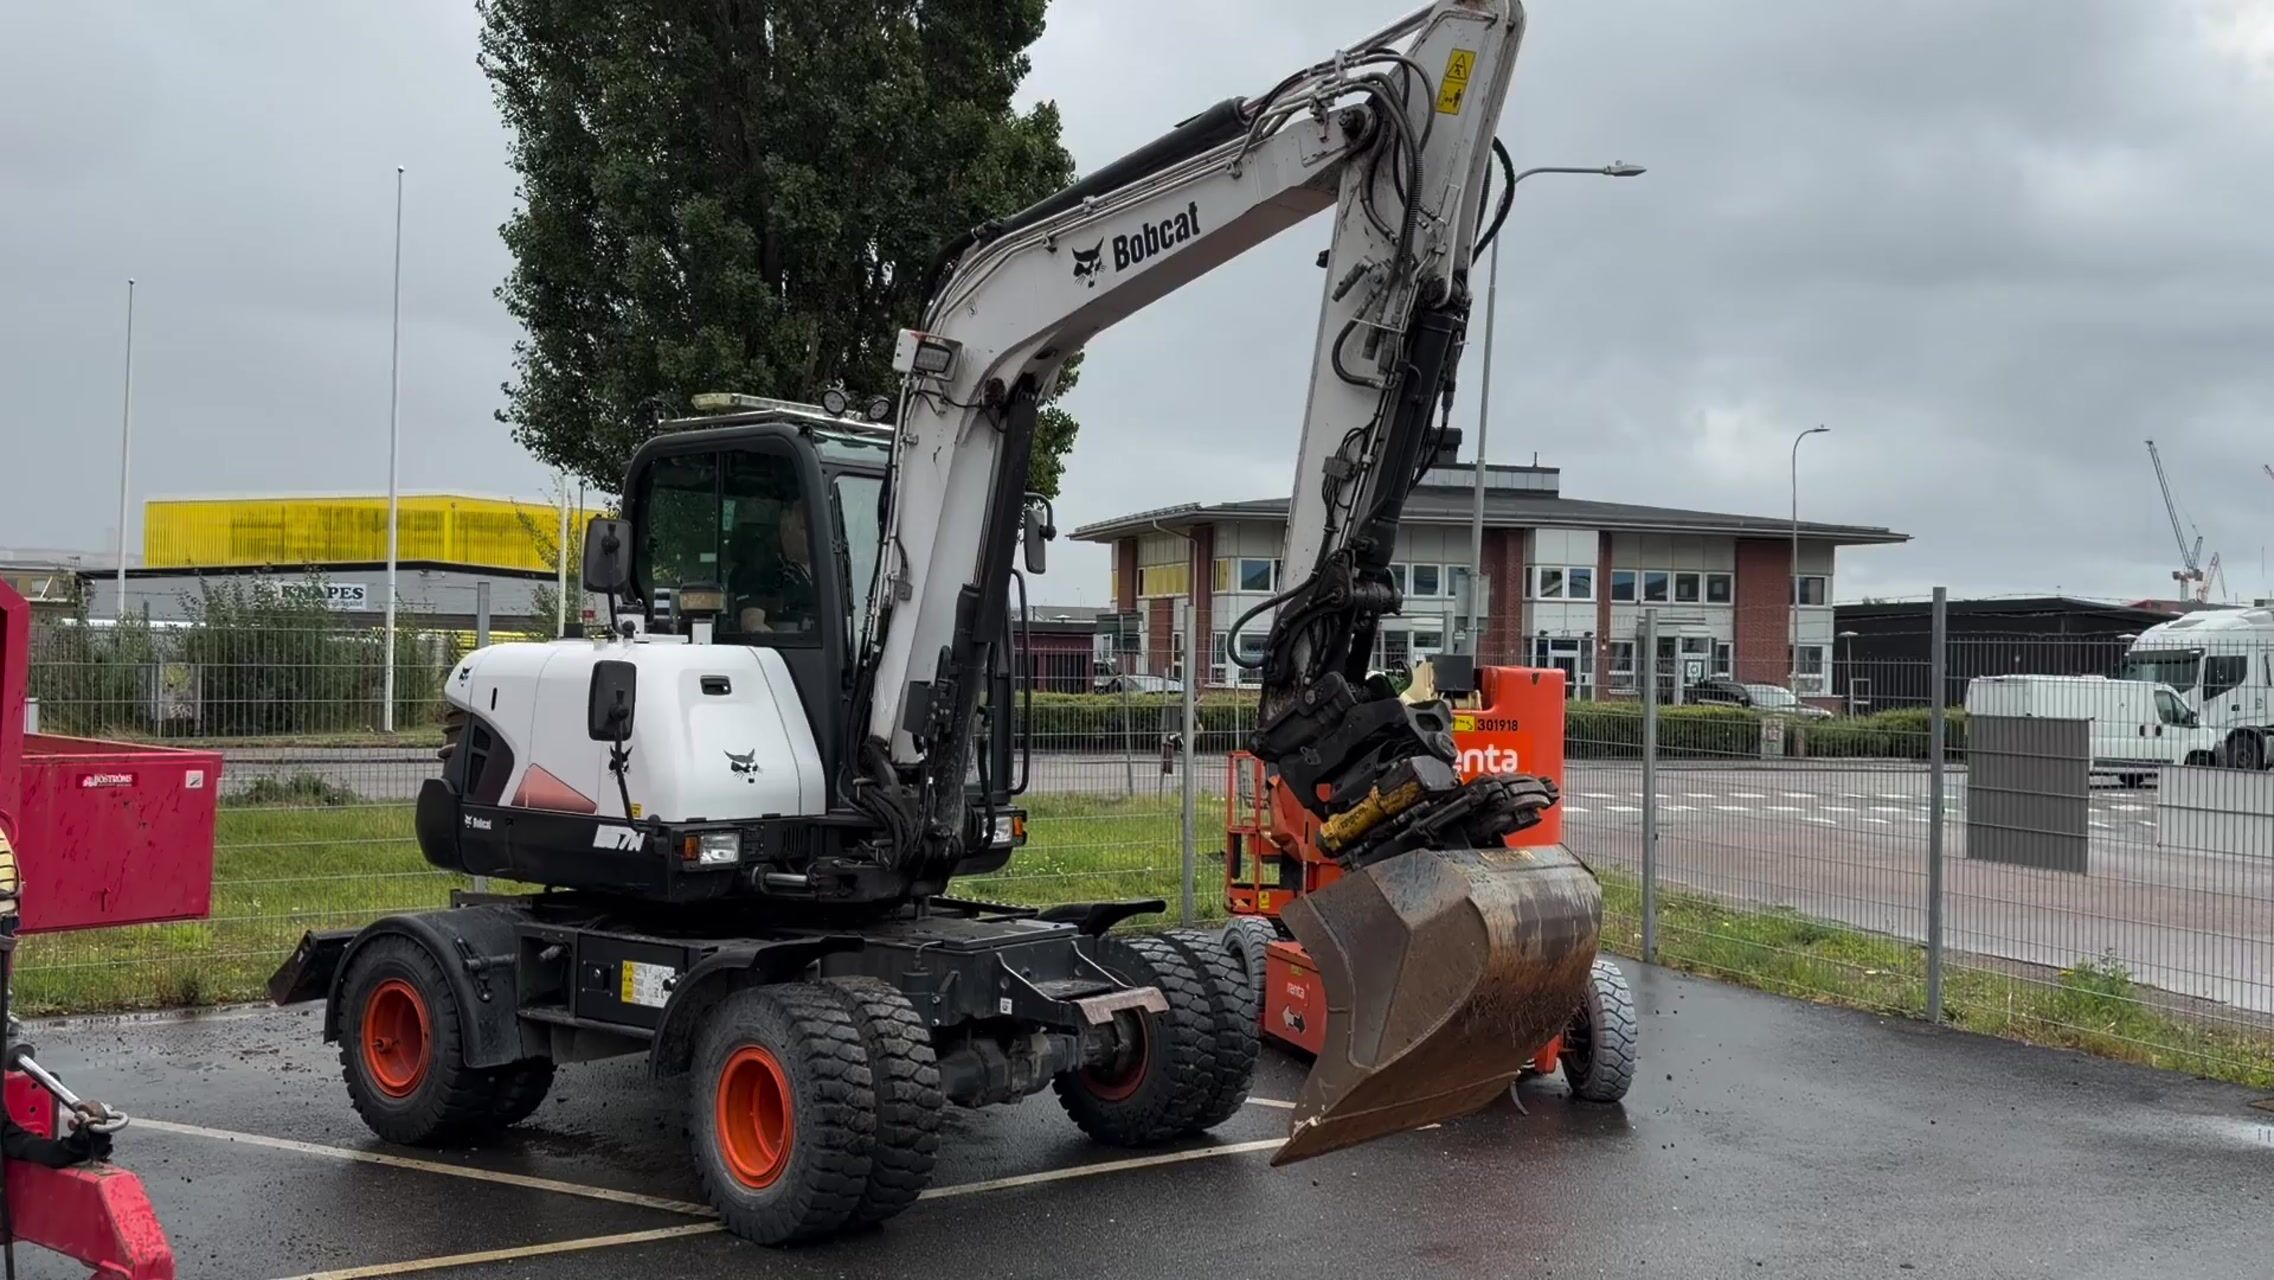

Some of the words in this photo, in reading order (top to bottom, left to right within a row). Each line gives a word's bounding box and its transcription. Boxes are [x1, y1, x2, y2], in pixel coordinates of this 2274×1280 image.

[1112, 201, 1200, 272] Bobcat
[1477, 718, 1519, 732] 301918
[1453, 743, 1518, 774] enta
